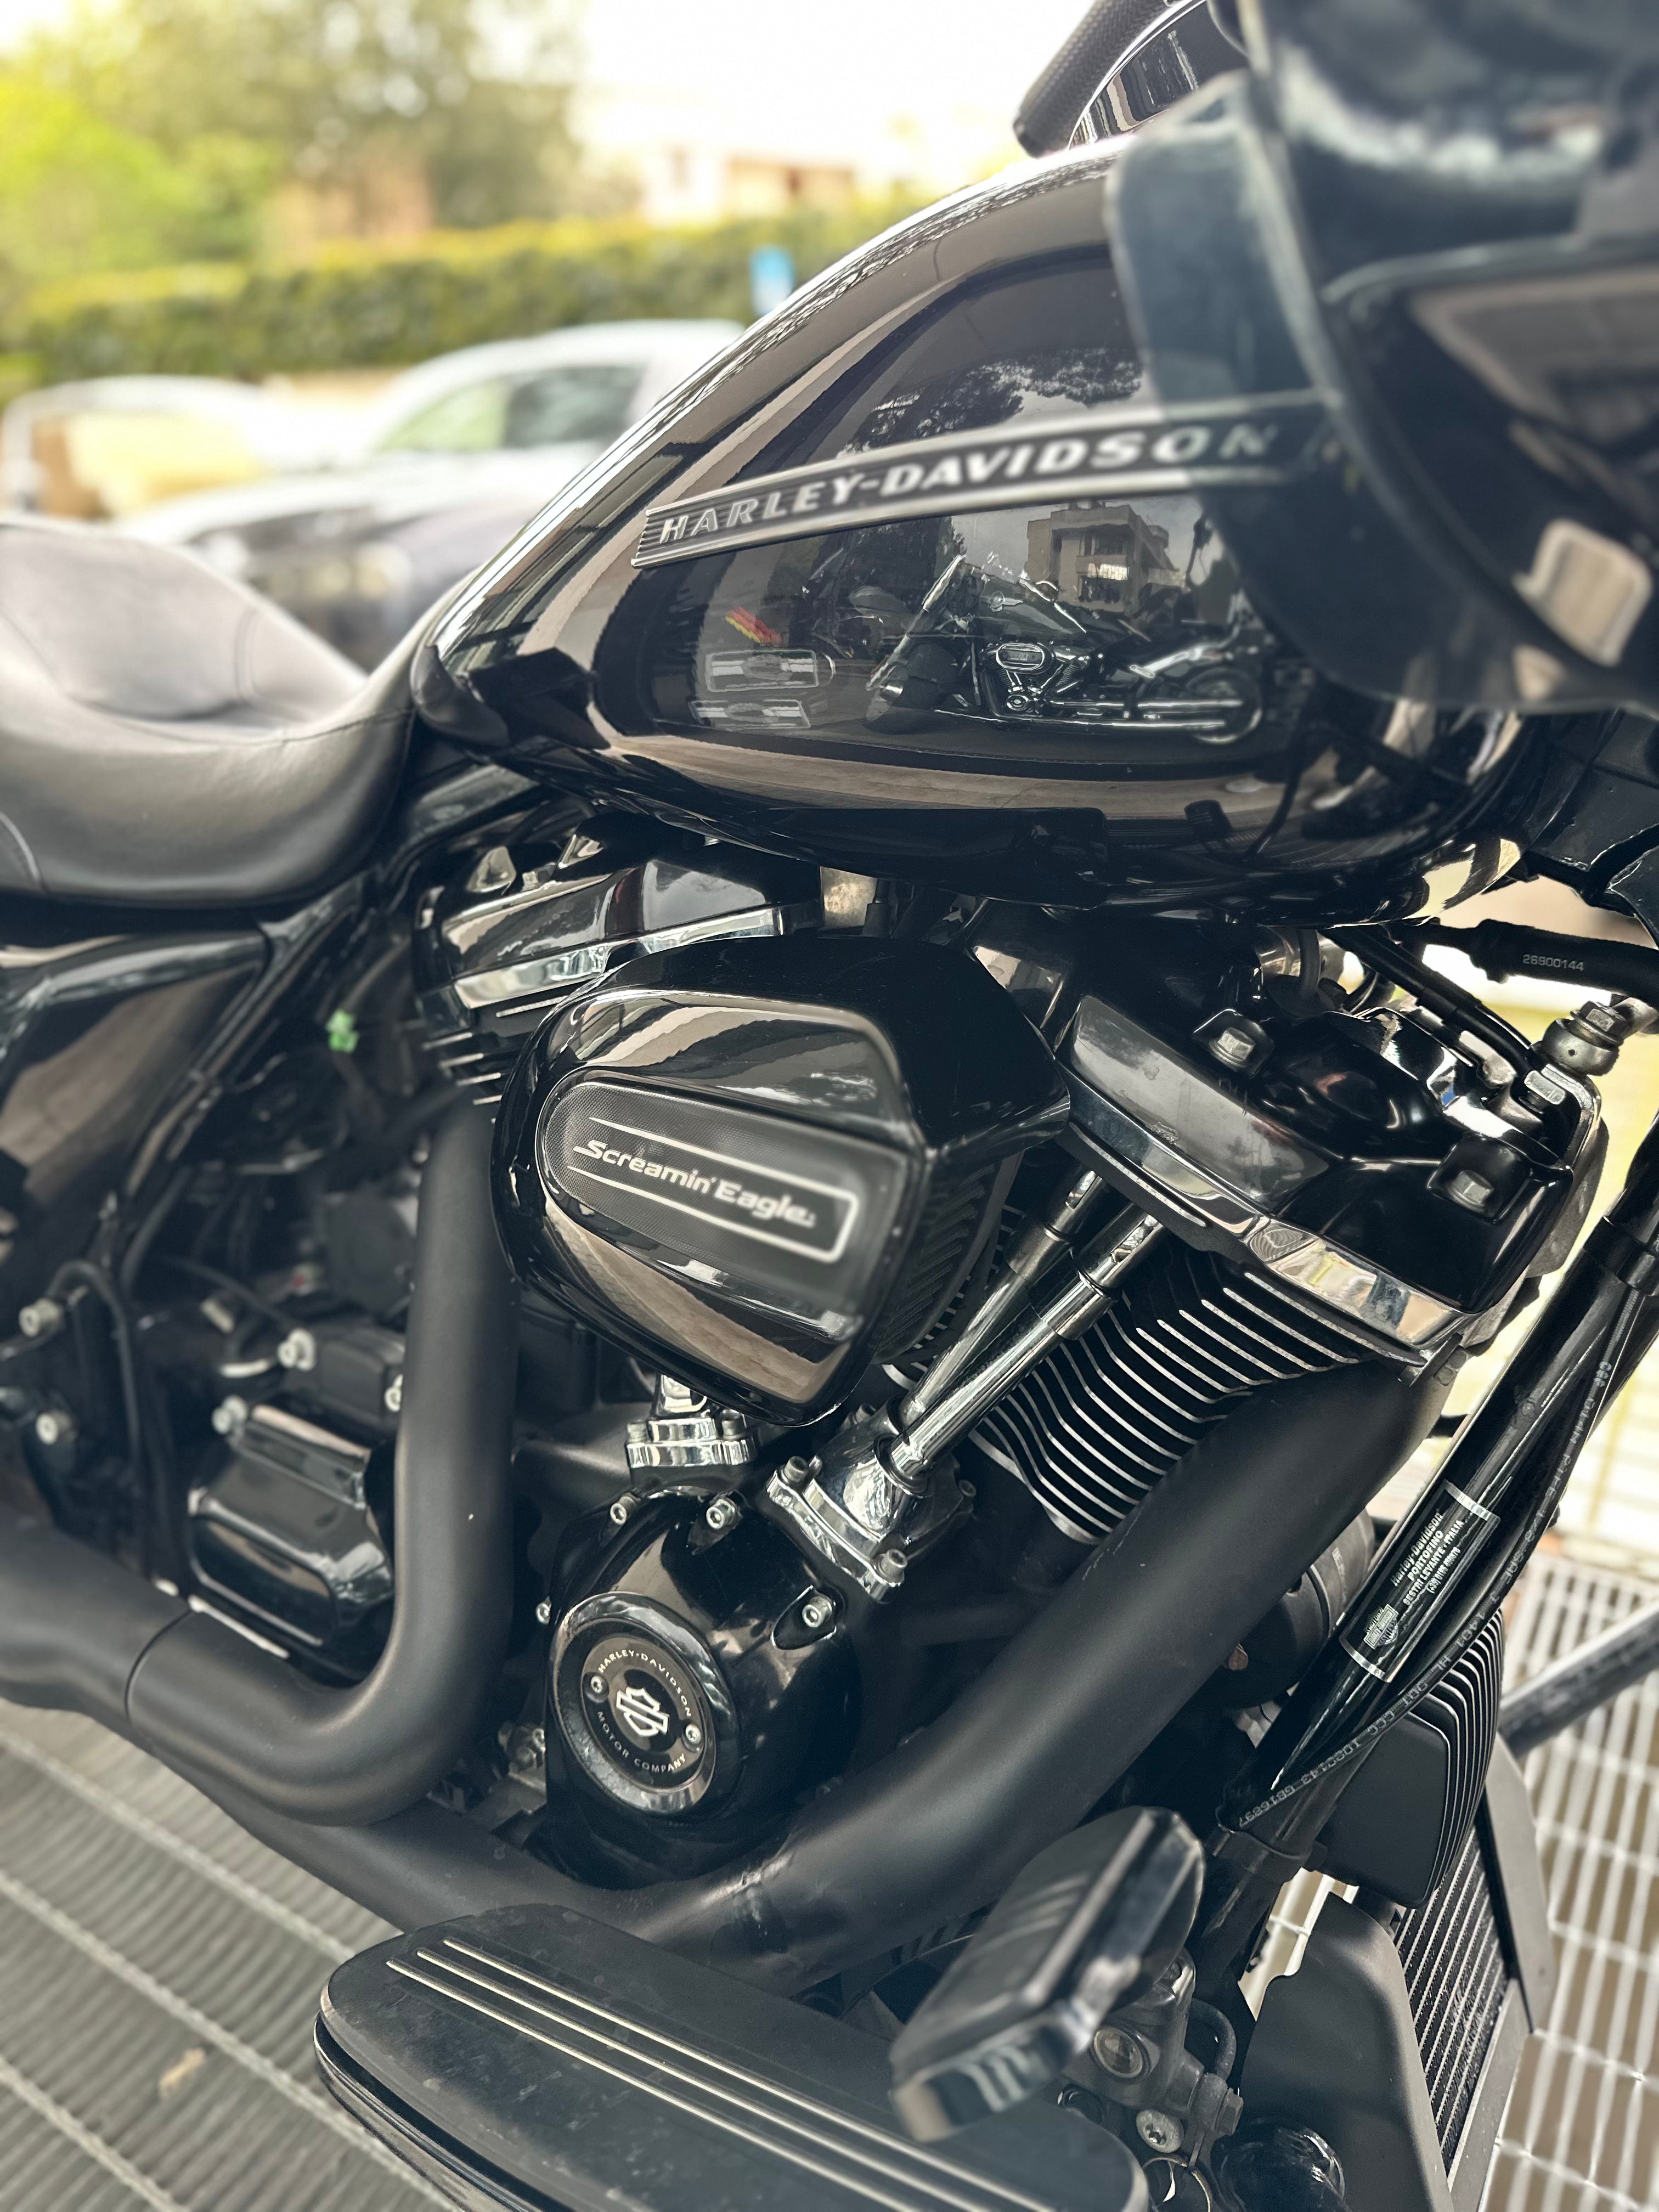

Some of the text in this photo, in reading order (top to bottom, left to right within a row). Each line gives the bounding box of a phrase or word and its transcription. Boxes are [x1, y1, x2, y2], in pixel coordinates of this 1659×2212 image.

[659, 424, 1280, 543] HARLEY-DAVIDSON
[573, 1139, 716, 1194] Screamin'
[1402, 1519, 1465, 1606] SESTRI LEVANTE ITALIA
[1407, 1528, 1444, 1582] PORTOFINO
[599, 1650, 692, 1717] HARLEY-DAVIDSON
[597, 1711, 686, 1773] MOTOR COMPANY
